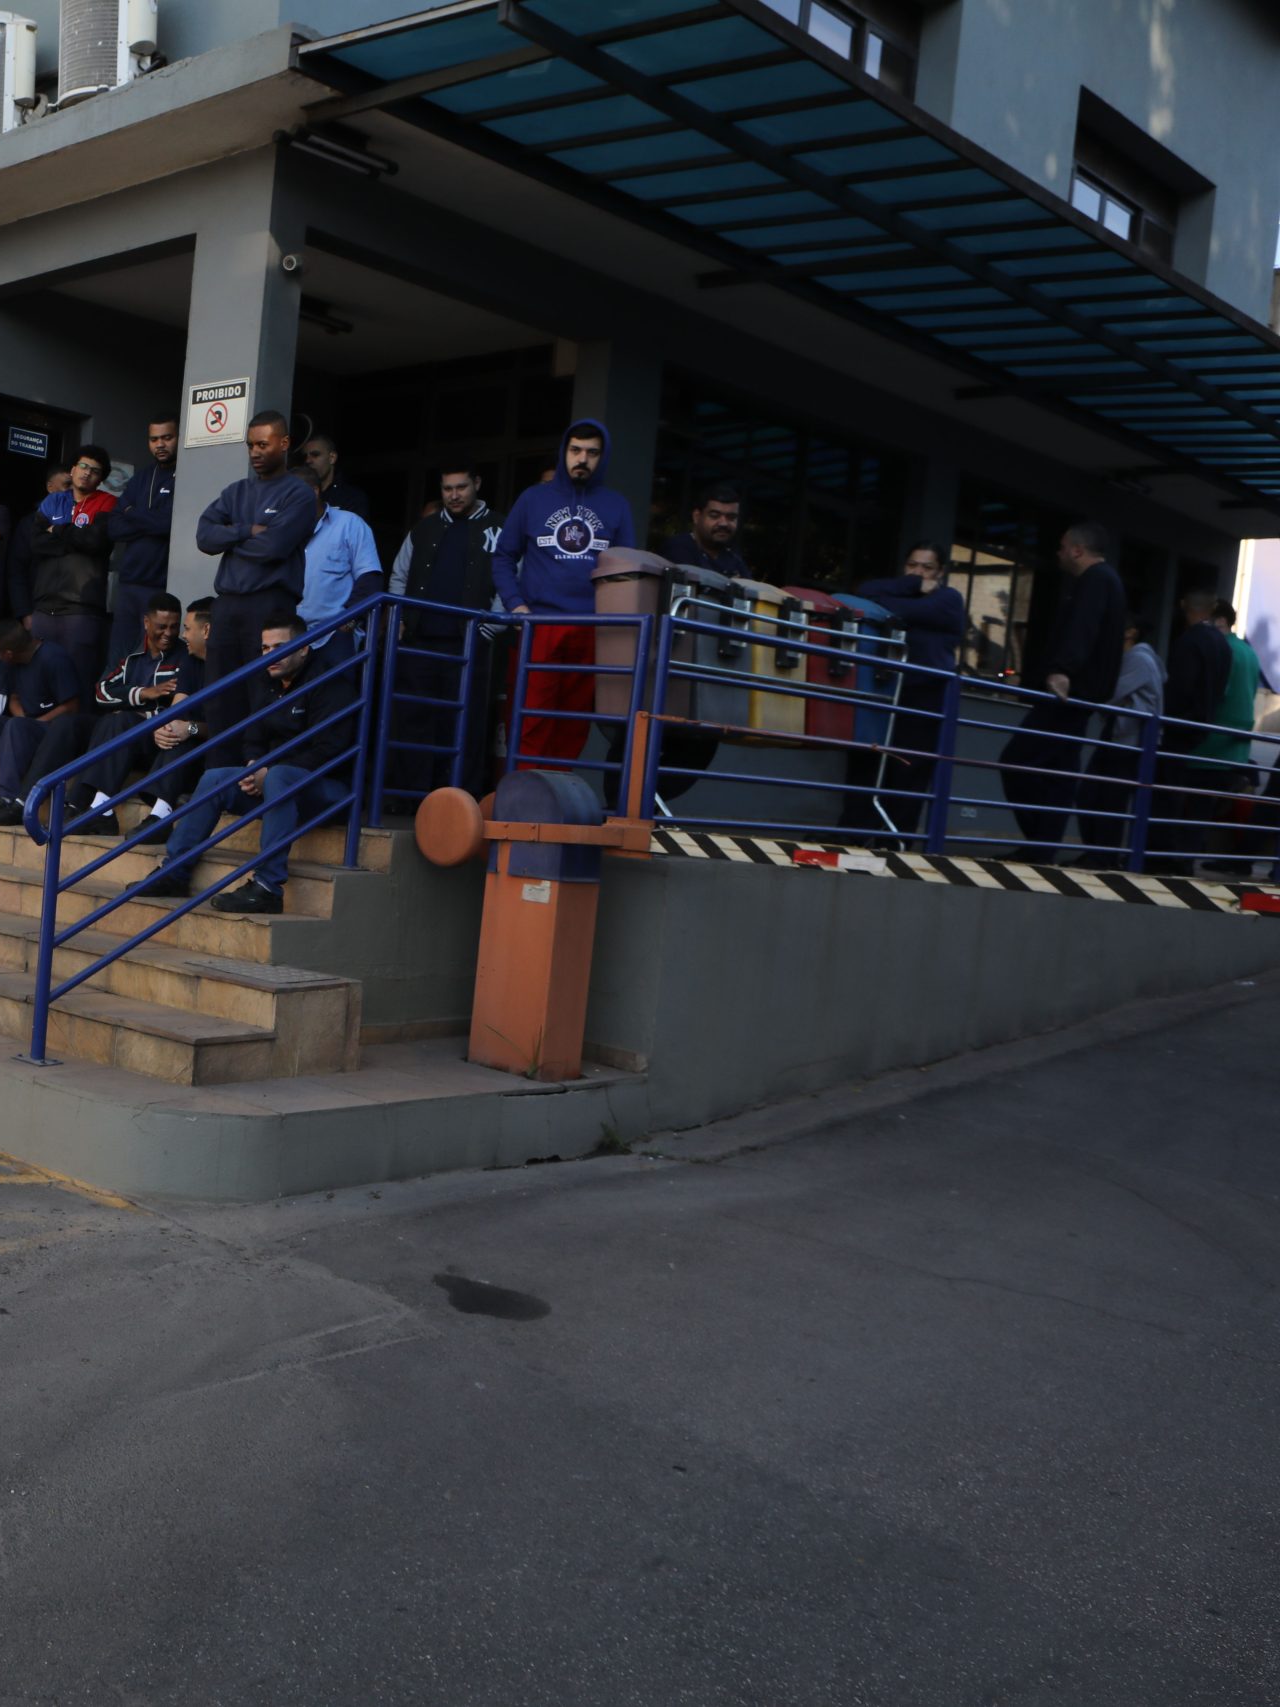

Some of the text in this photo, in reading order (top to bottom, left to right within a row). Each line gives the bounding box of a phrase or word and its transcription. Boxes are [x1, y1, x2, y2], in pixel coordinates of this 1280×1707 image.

[196, 385, 241, 402] PROIBIDO
[13, 433, 43, 444] SEGURANÇA
[19, 441, 45, 452] TRABALHO
[544, 505, 604, 531] NEW YORK
[483, 526, 502, 553] NY
